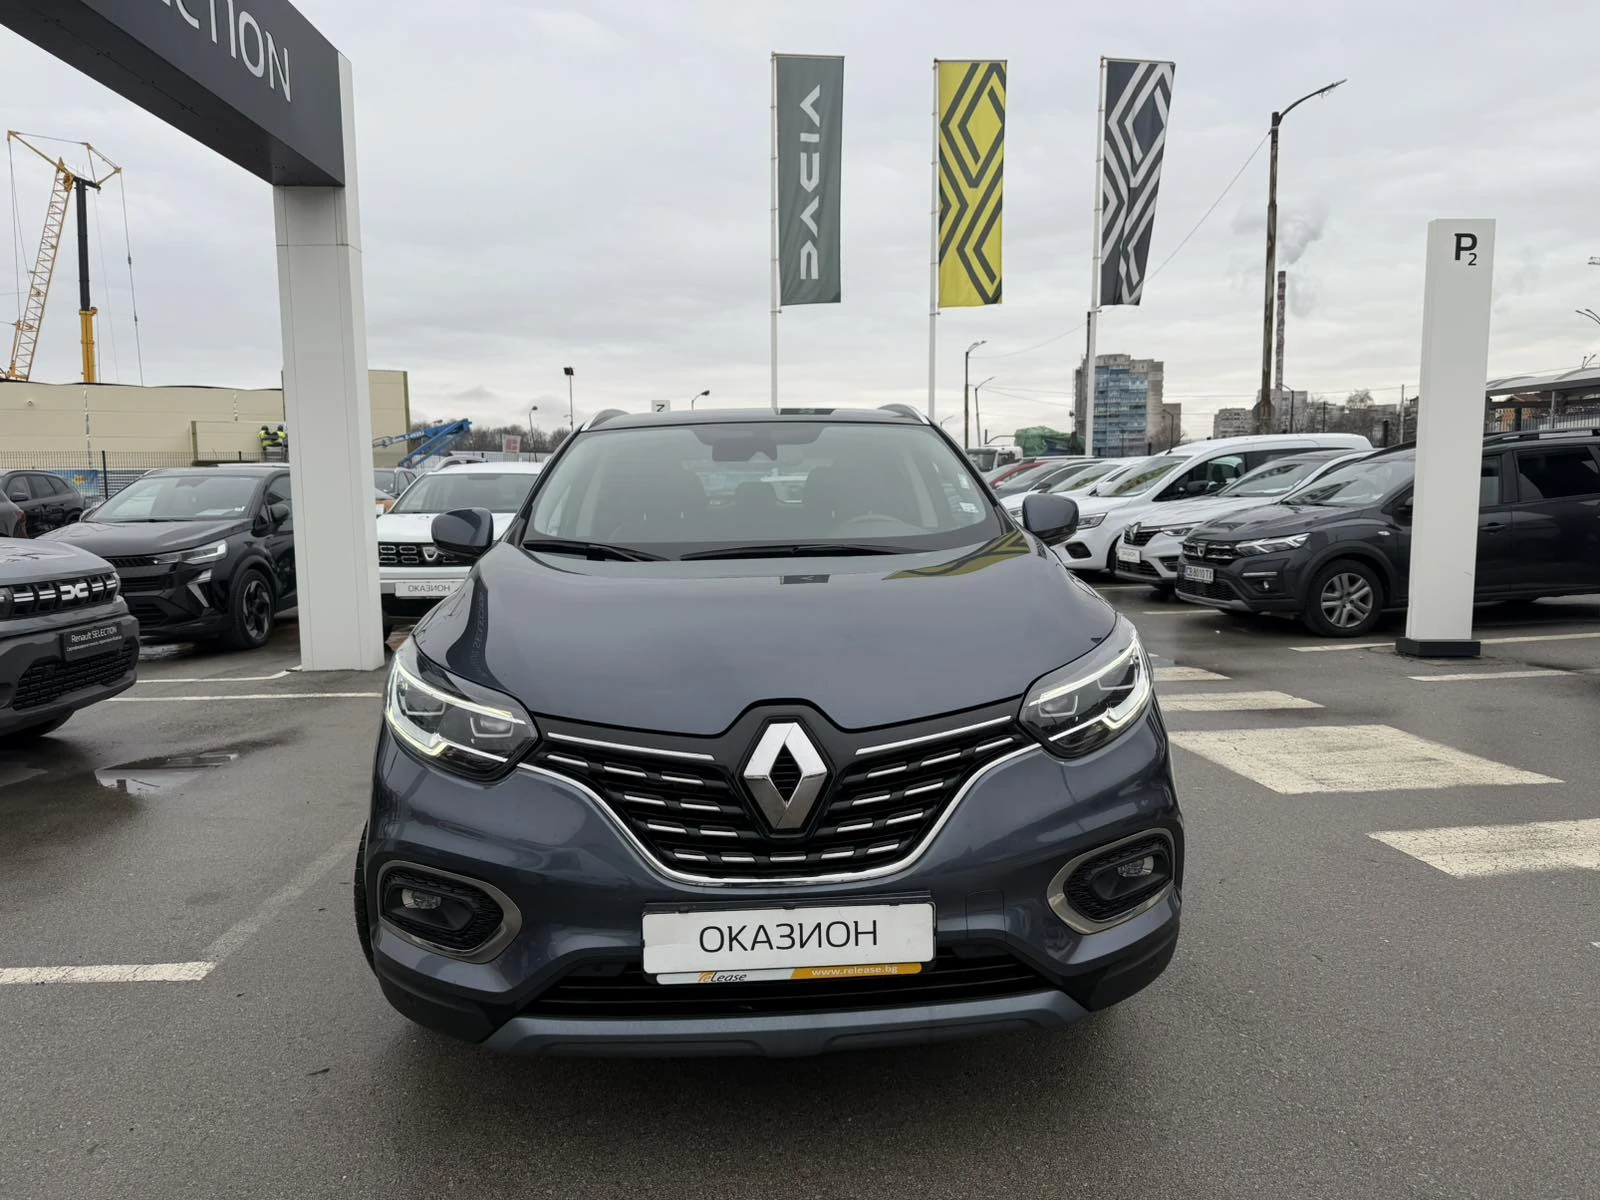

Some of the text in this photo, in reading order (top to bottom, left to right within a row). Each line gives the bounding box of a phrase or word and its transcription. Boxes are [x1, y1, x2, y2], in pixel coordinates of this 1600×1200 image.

[800, 84, 820, 280] DACIA
[71, 632, 91, 643] Renault
[699, 919, 879, 953] ОКАЗИОН
[811, 964, 899, 976] www.release.bg
